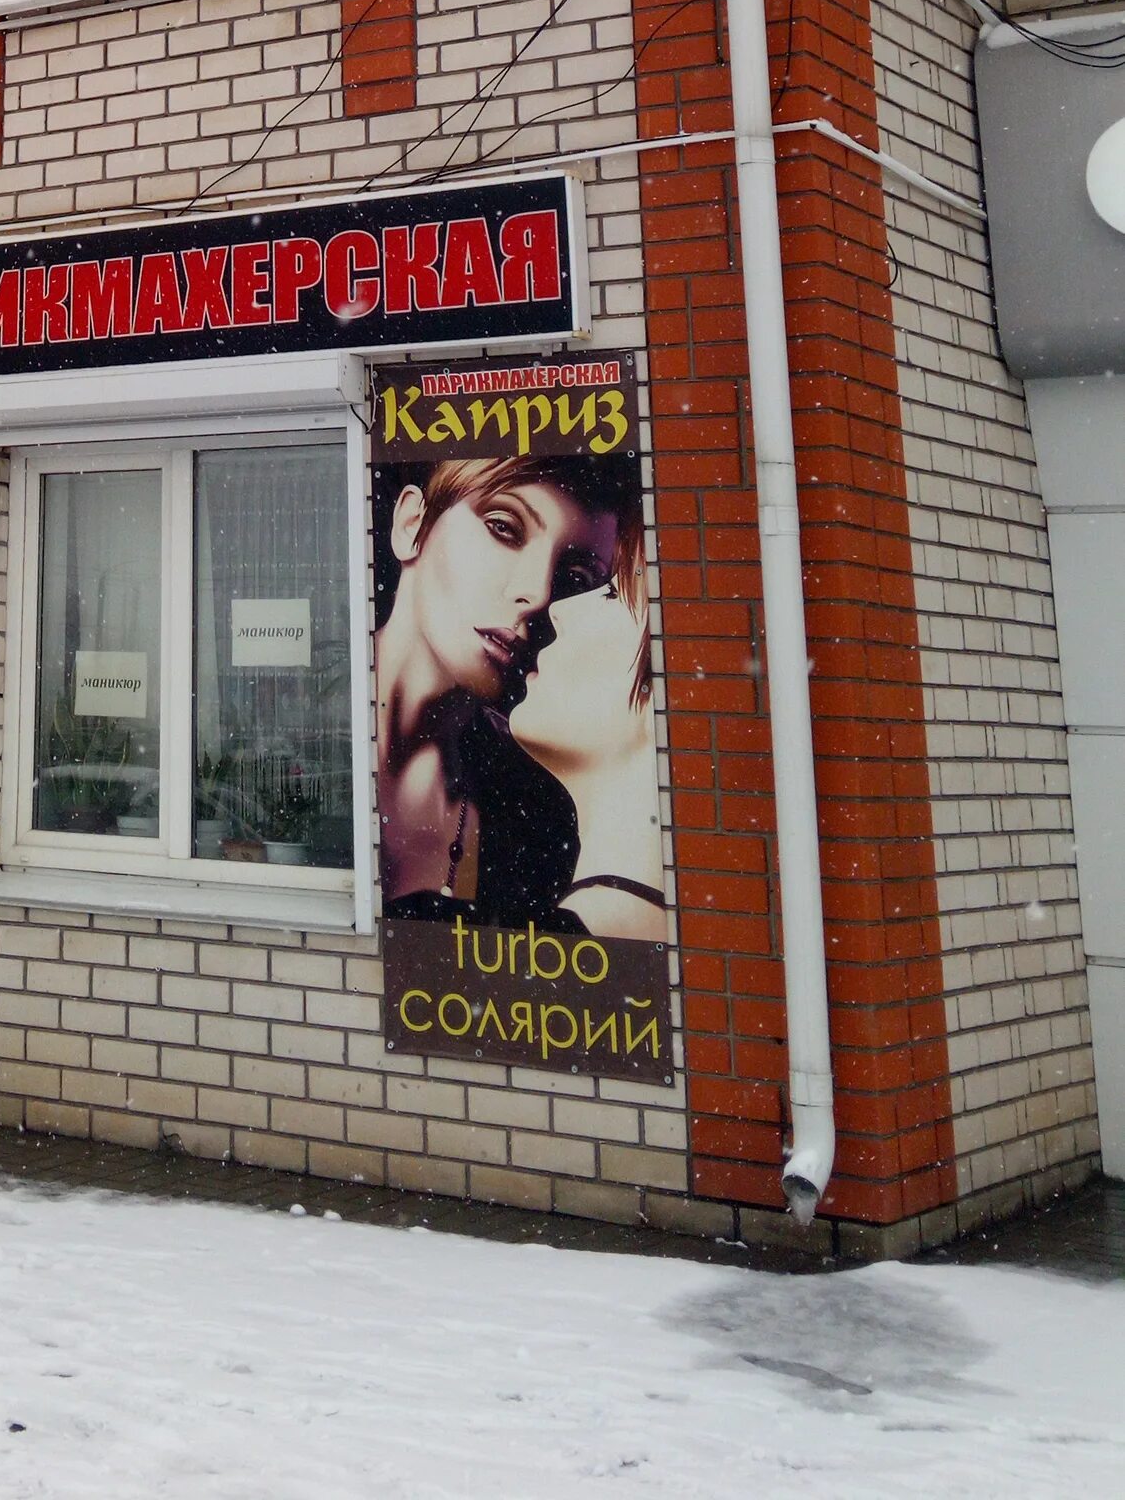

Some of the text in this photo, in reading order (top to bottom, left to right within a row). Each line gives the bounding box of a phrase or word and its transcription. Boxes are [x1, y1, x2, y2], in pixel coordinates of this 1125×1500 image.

[421, 361, 621, 396] ПАРИКМАХЕРСКАЯ
[380, 386, 629, 456] Каприз
[238, 623, 305, 642] маникюр
[81, 675, 142, 695] маникюр
[451, 914, 610, 984] turbo
[399, 989, 660, 1060] солярий
